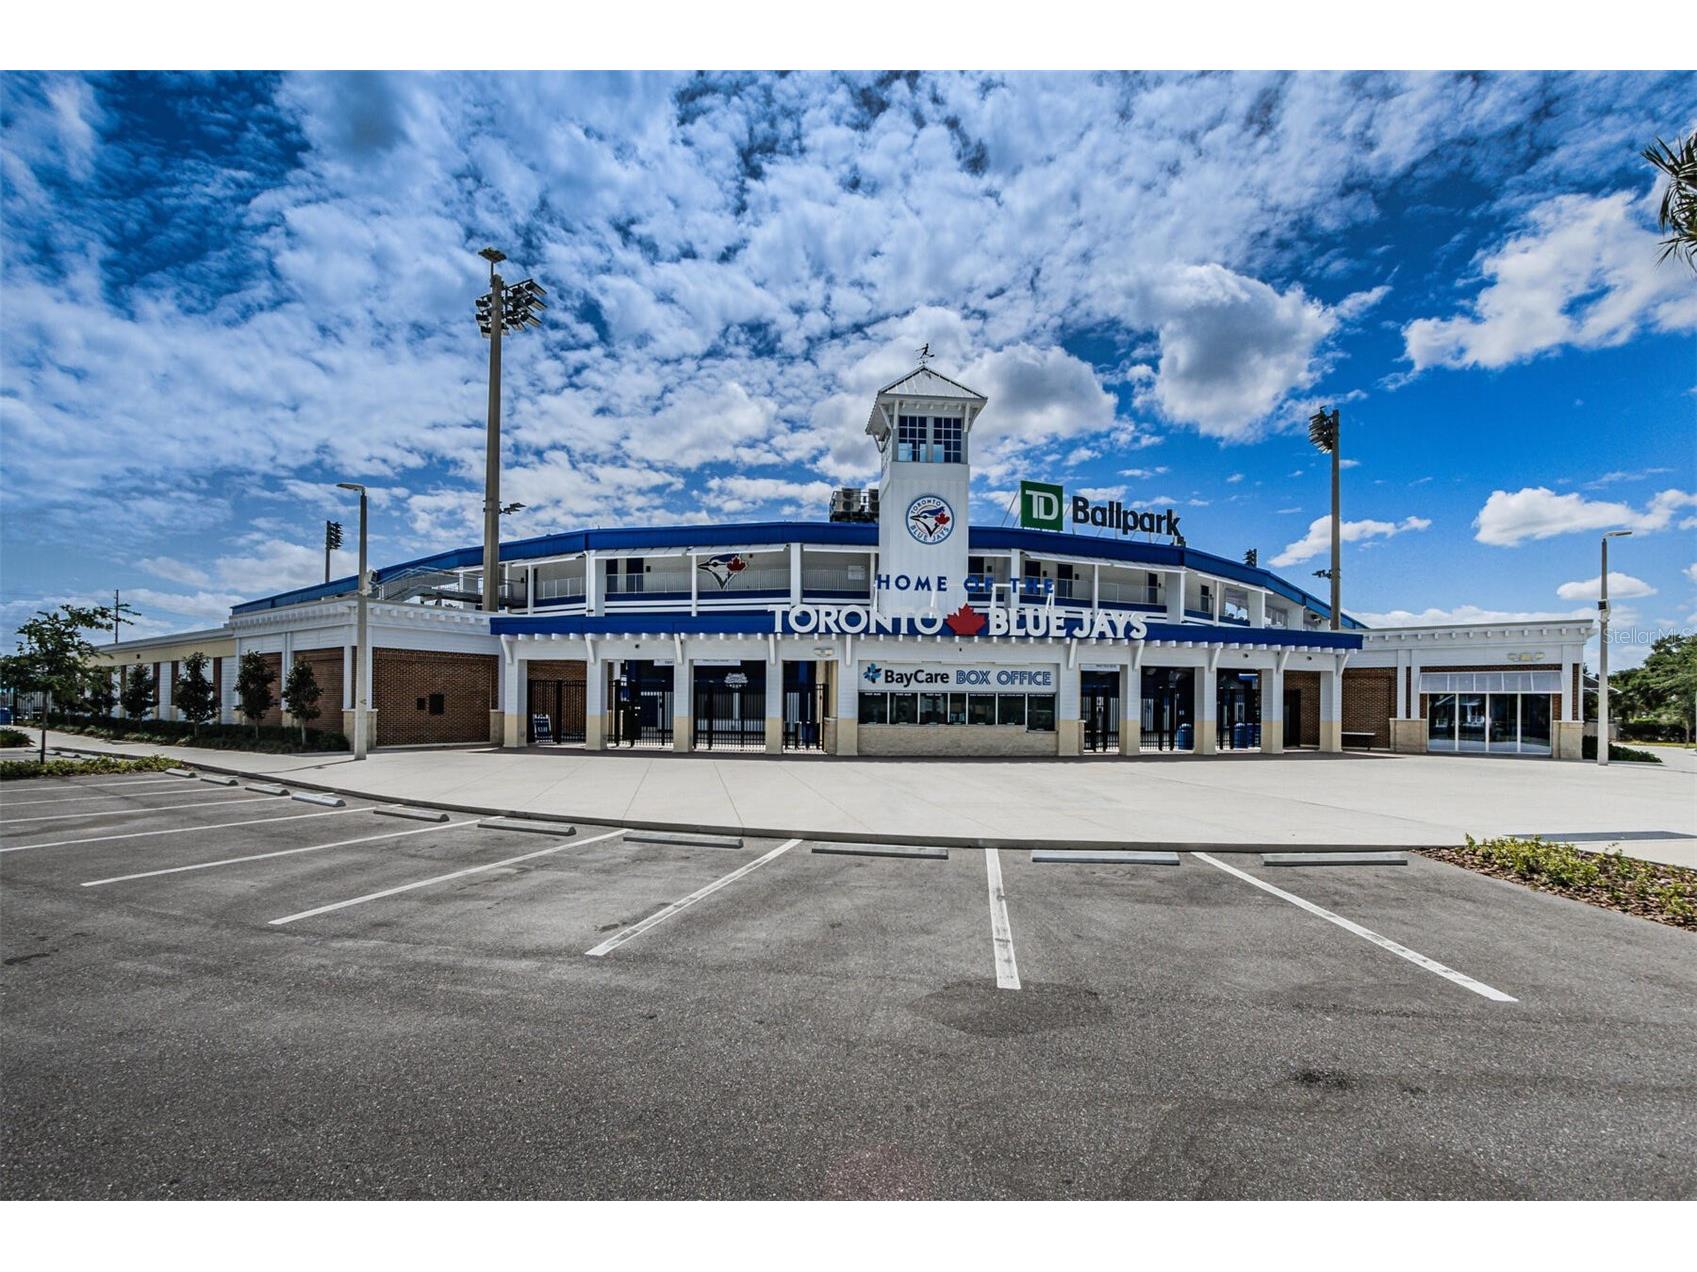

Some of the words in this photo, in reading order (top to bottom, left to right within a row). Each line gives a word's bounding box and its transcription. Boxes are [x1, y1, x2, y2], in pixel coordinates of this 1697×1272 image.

[911, 499, 941, 514] TORONTO
[1025, 490, 1059, 520] TD
[1072, 496, 1181, 536] Ballpark
[910, 525, 928, 541] BLUE
[933, 527, 949, 540] JAYS
[877, 574, 947, 591] HOME
[964, 575, 994, 593] OF
[1010, 577, 1054, 594] THE
[768, 604, 944, 635] TORONTO
[988, 607, 1067, 637] BLUE
[1072, 609, 1148, 639] JAYS
[884, 669, 949, 687] BayCare
[956, 670, 991, 685] BOX
[996, 670, 1052, 686] OFFICE
